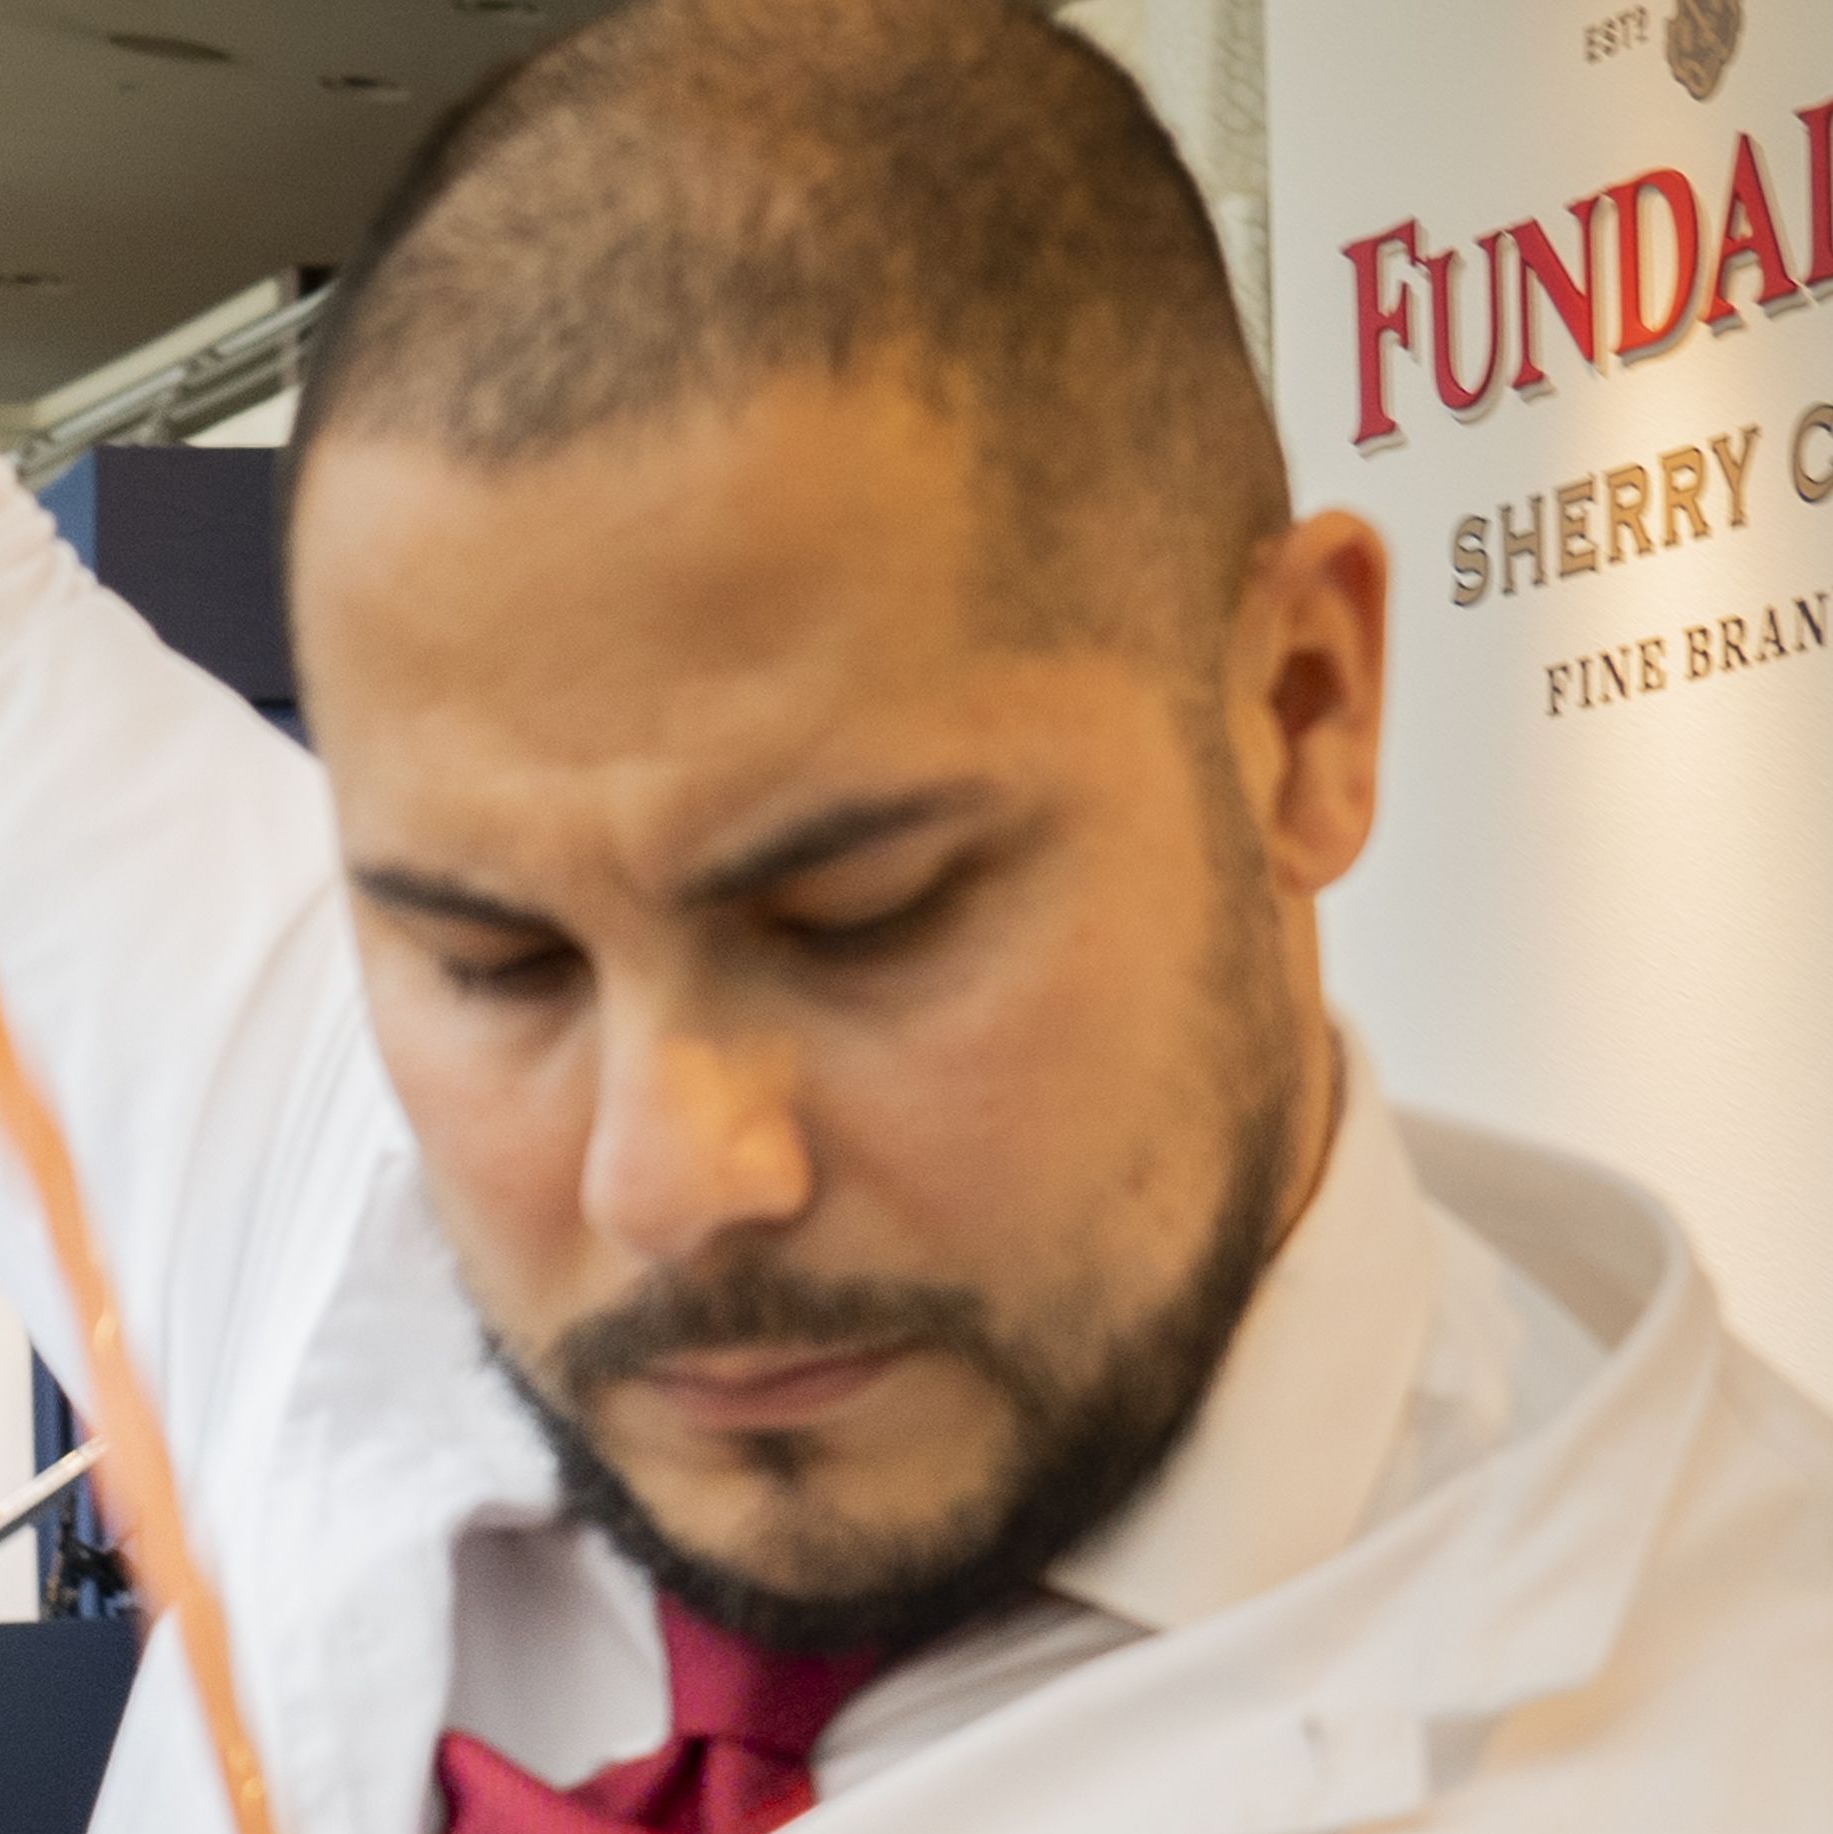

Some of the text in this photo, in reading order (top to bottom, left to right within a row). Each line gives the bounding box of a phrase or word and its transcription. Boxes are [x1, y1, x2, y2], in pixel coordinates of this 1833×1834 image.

[1450, 424, 1761, 606] SHERRY
[1544, 591, 1830, 717] FINE BRAN
